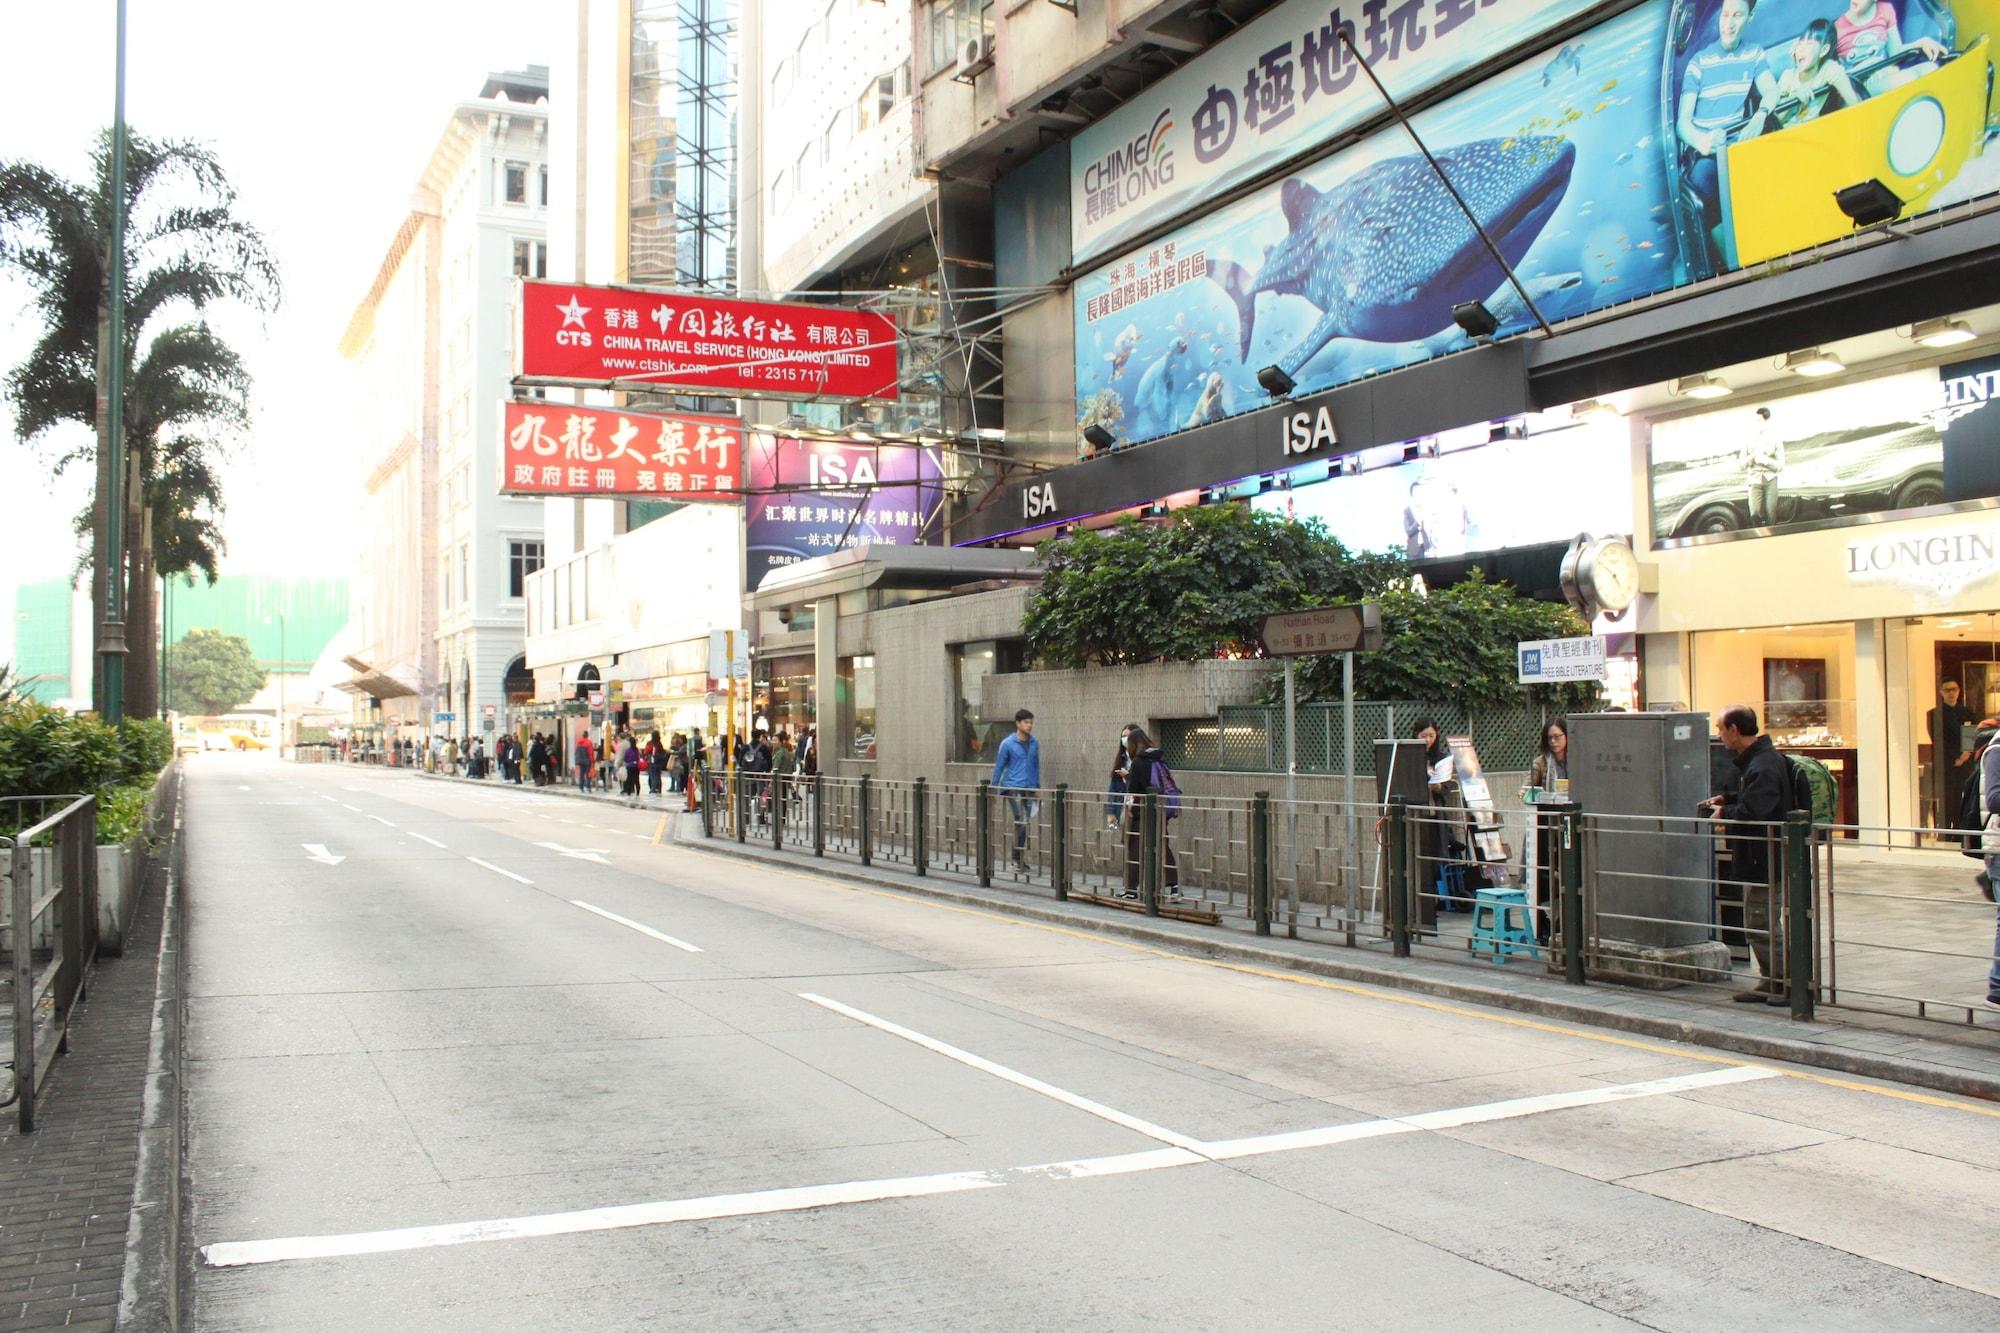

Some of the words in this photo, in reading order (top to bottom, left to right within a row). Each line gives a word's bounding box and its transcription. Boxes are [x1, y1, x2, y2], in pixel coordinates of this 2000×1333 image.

[1084, 130, 1151, 195] CHIME
[1116, 150, 1174, 207] LONG
[1085, 184, 1116, 225] 長隆
[1086, 250, 1206, 322] 長隆國際海洋度假區
[555, 329, 593, 347] CTS
[603, 307, 639, 330] 香港
[806, 324, 870, 346] 有限公司
[602, 357, 709, 375] www.ctshk.com
[765, 366, 797, 381] 2315
[603, 335, 642, 350] CHINA
[644, 338, 691, 355] TRAVEL
[693, 342, 745, 358] SERVICE
[746, 344, 784, 361] (HONG
[787, 347, 825, 364] KONG)
[827, 351, 871, 367] LIMITED
[510, 413, 737, 470] 九龍大藥行
[1283, 406, 1338, 455] ISA
[513, 464, 616, 489] 政府註冊
[809, 453, 880, 492] ISA
[765, 504, 925, 527] 汇聚世界时尚名牌精品
[1024, 482, 1057, 519] ISA
[1313, 614, 1335, 625] Road
[1525, 652, 1538, 664] JW
[1541, 666, 1555, 678] FREE
[1555, 665, 1570, 677] BIBLE
[1570, 663, 1603, 676] LITERATURE
